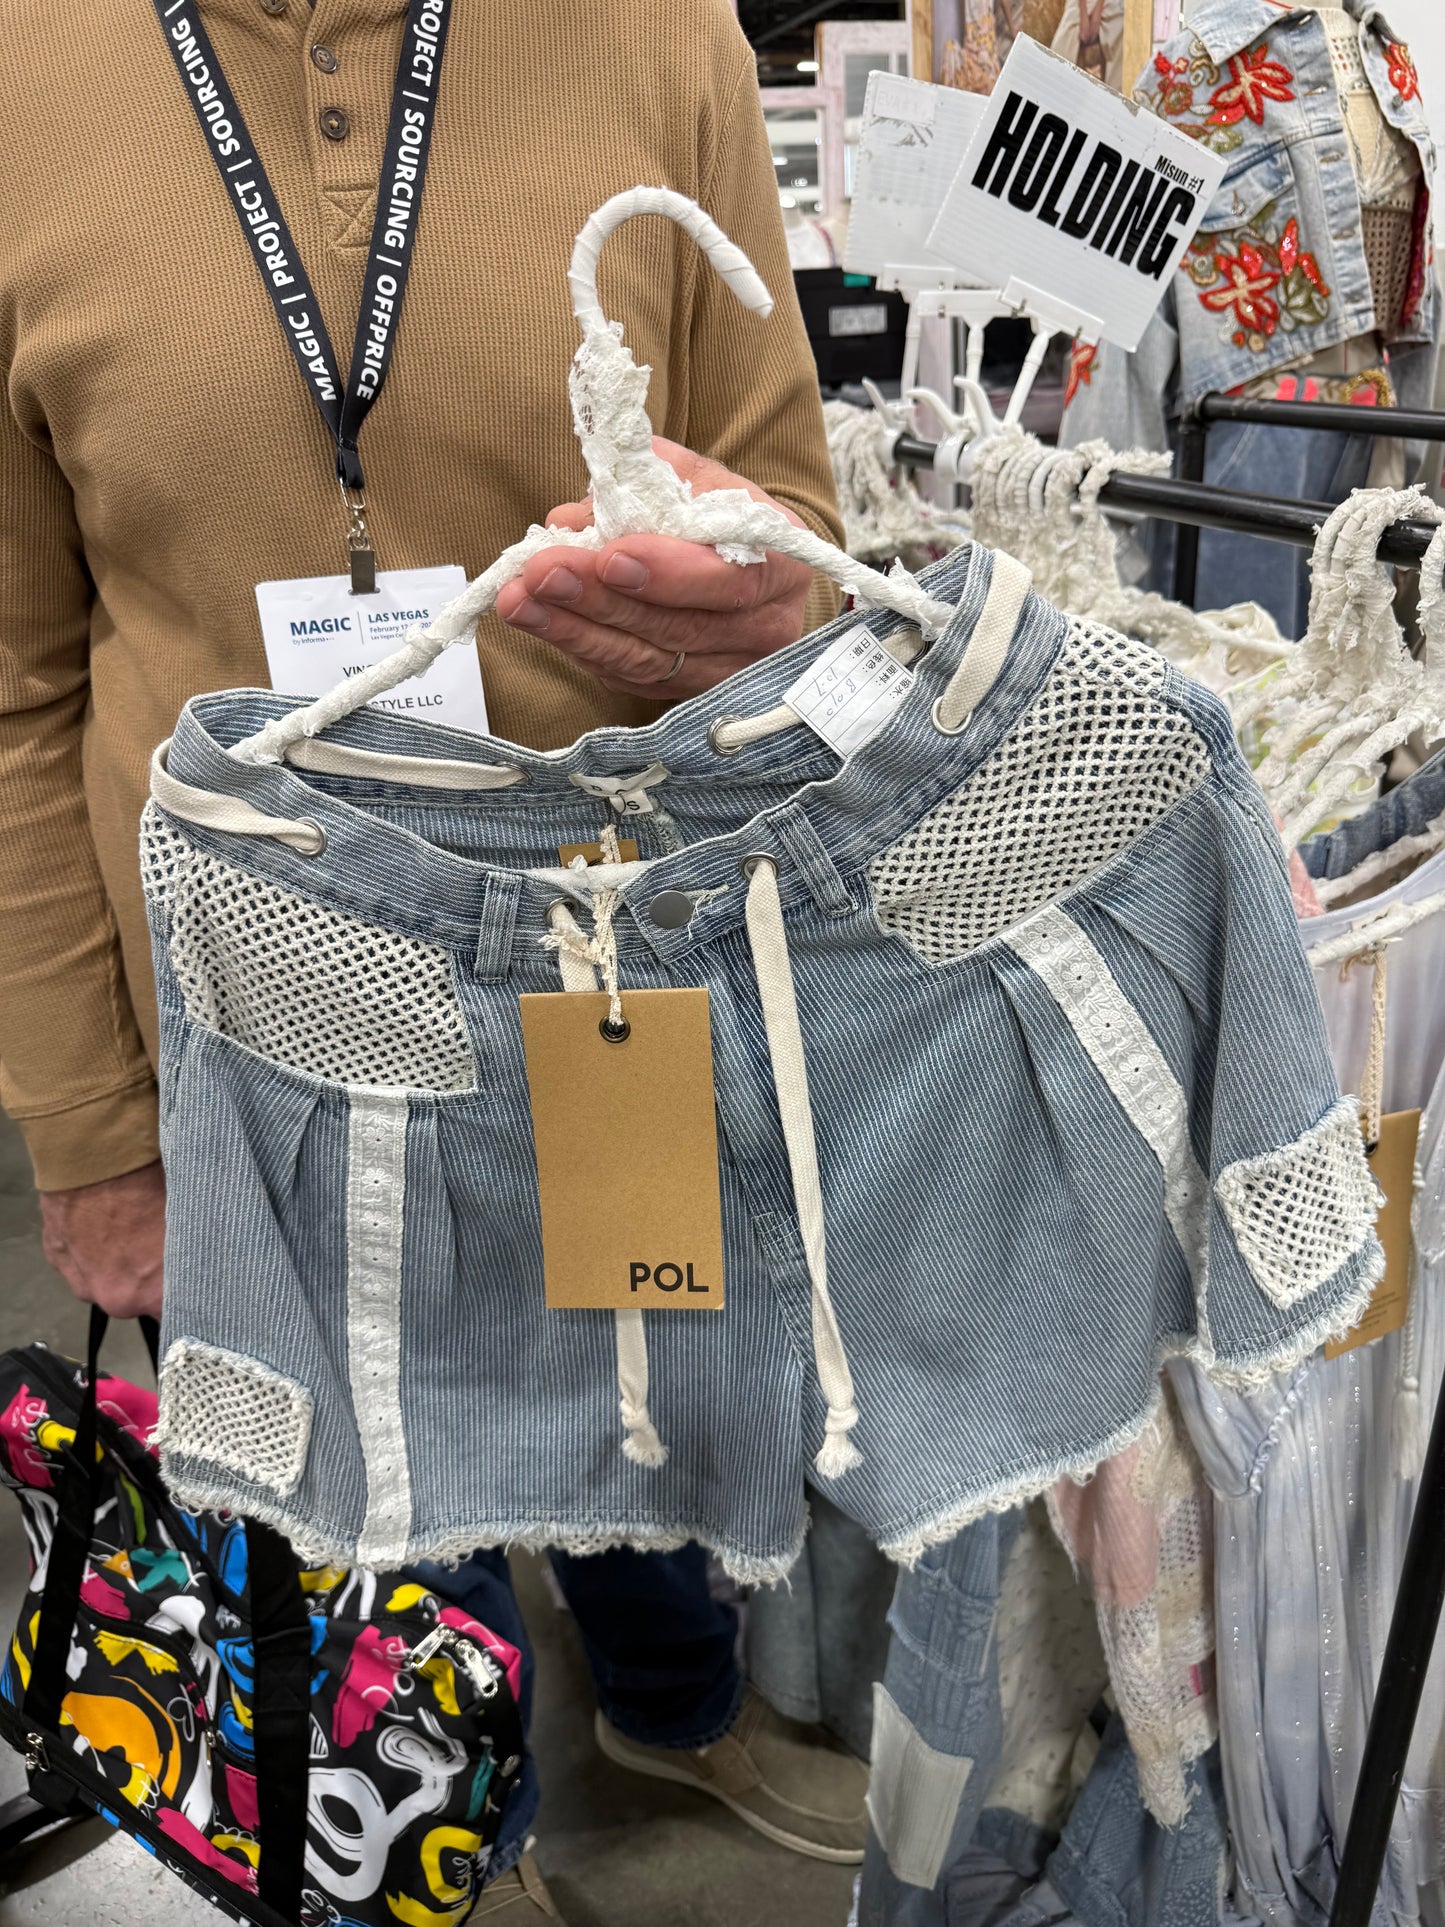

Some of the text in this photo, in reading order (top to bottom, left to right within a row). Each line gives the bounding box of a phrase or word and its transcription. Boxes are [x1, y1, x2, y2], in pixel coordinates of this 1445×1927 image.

[970, 90, 1196, 281] HOLDING
[1154, 154, 1205, 194] Misun #1
[171, 18, 337, 401] MAGIC PROJECT SOURCING
[356, 0, 444, 401] ROJECT SOURCING OFFPRICE
[290, 617, 352, 636] MAGIC
[368, 609, 429, 624] LAS VEGAS
[369, 625, 400, 634] February
[417, 694, 443, 707] LLC
[626, 800, 640, 811] S
[629, 1261, 710, 1293] POL
